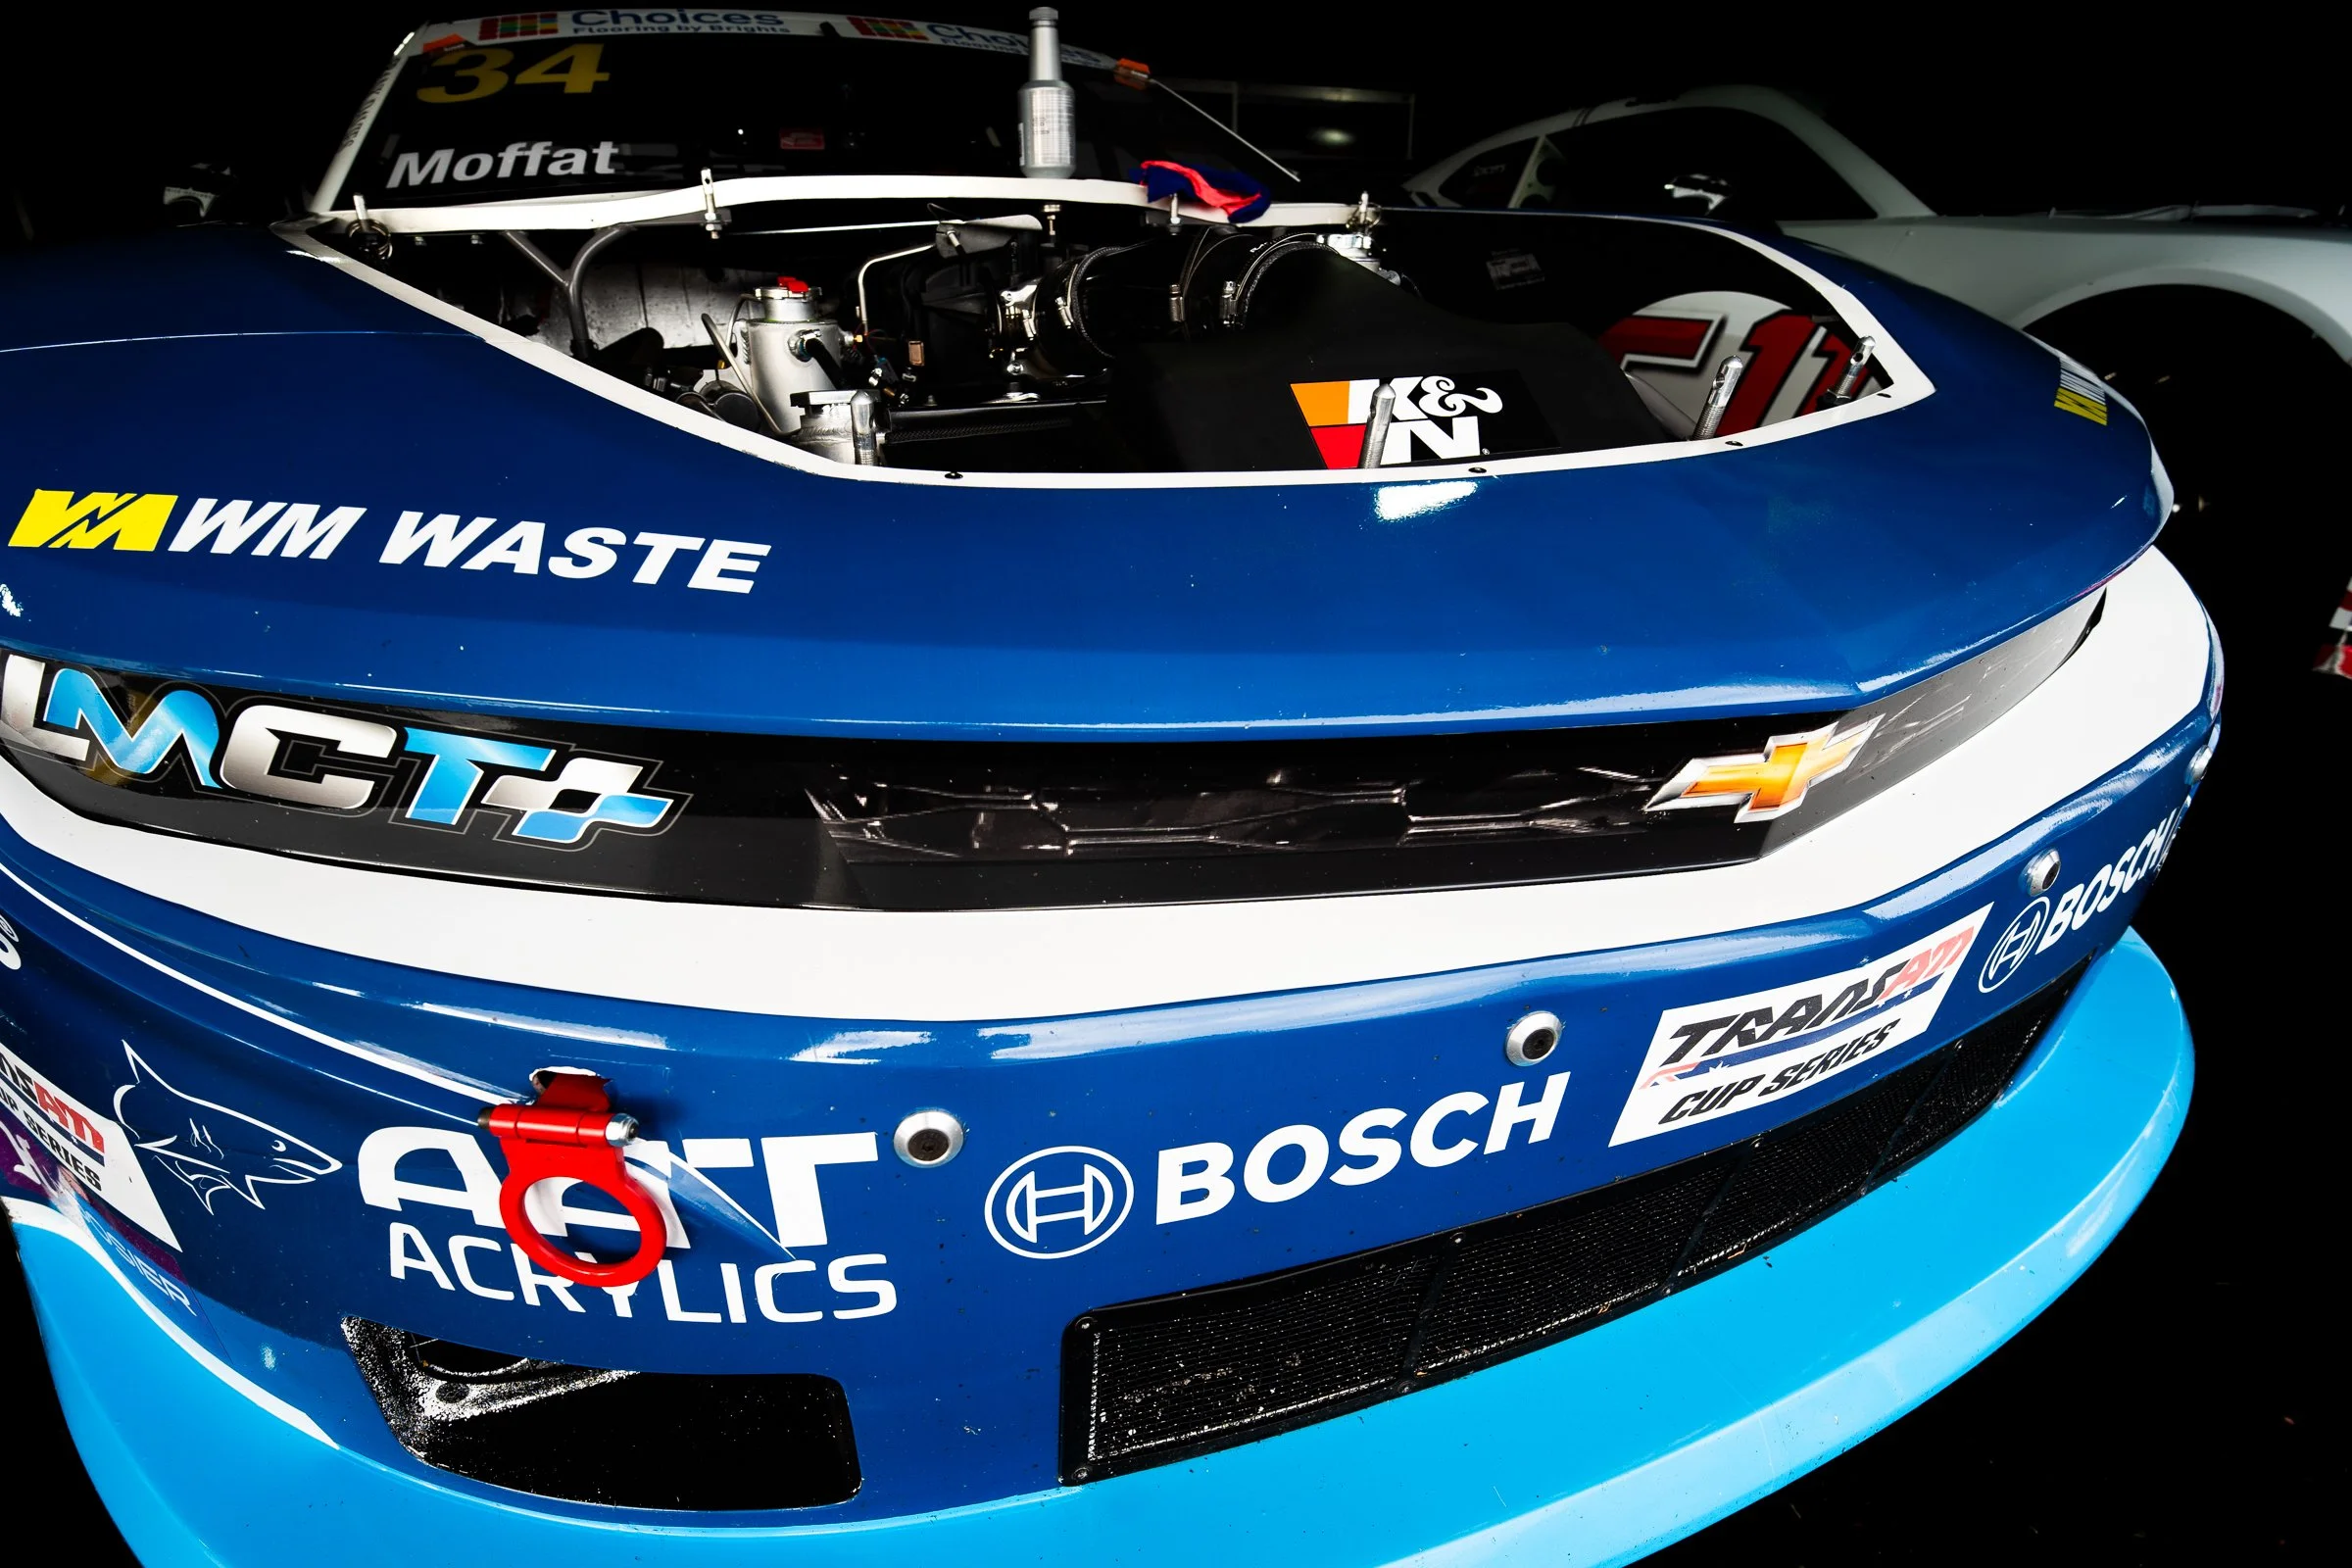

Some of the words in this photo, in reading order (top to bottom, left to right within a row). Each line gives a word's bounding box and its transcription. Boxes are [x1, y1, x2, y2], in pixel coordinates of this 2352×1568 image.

[571, 8, 784, 26] Choices
[573, 25, 670, 34] Flooring
[710, 25, 791, 34] Brights
[416, 43, 610, 103] 34
[385, 140, 619, 189] Moffat
[168, 498, 367, 559] WM
[379, 511, 772, 593] WASTE
[2, 653, 672, 844] LMCT+
[2035, 808, 2178, 956] BOSCH
[1657, 1073, 1766, 1125] CUP
[1757, 1018, 1902, 1098] SERIES
[24, 1109, 102, 1192] SERIES
[1155, 1071, 1571, 1225] BOSCH
[388, 1221, 898, 1324] ACRYLICS
